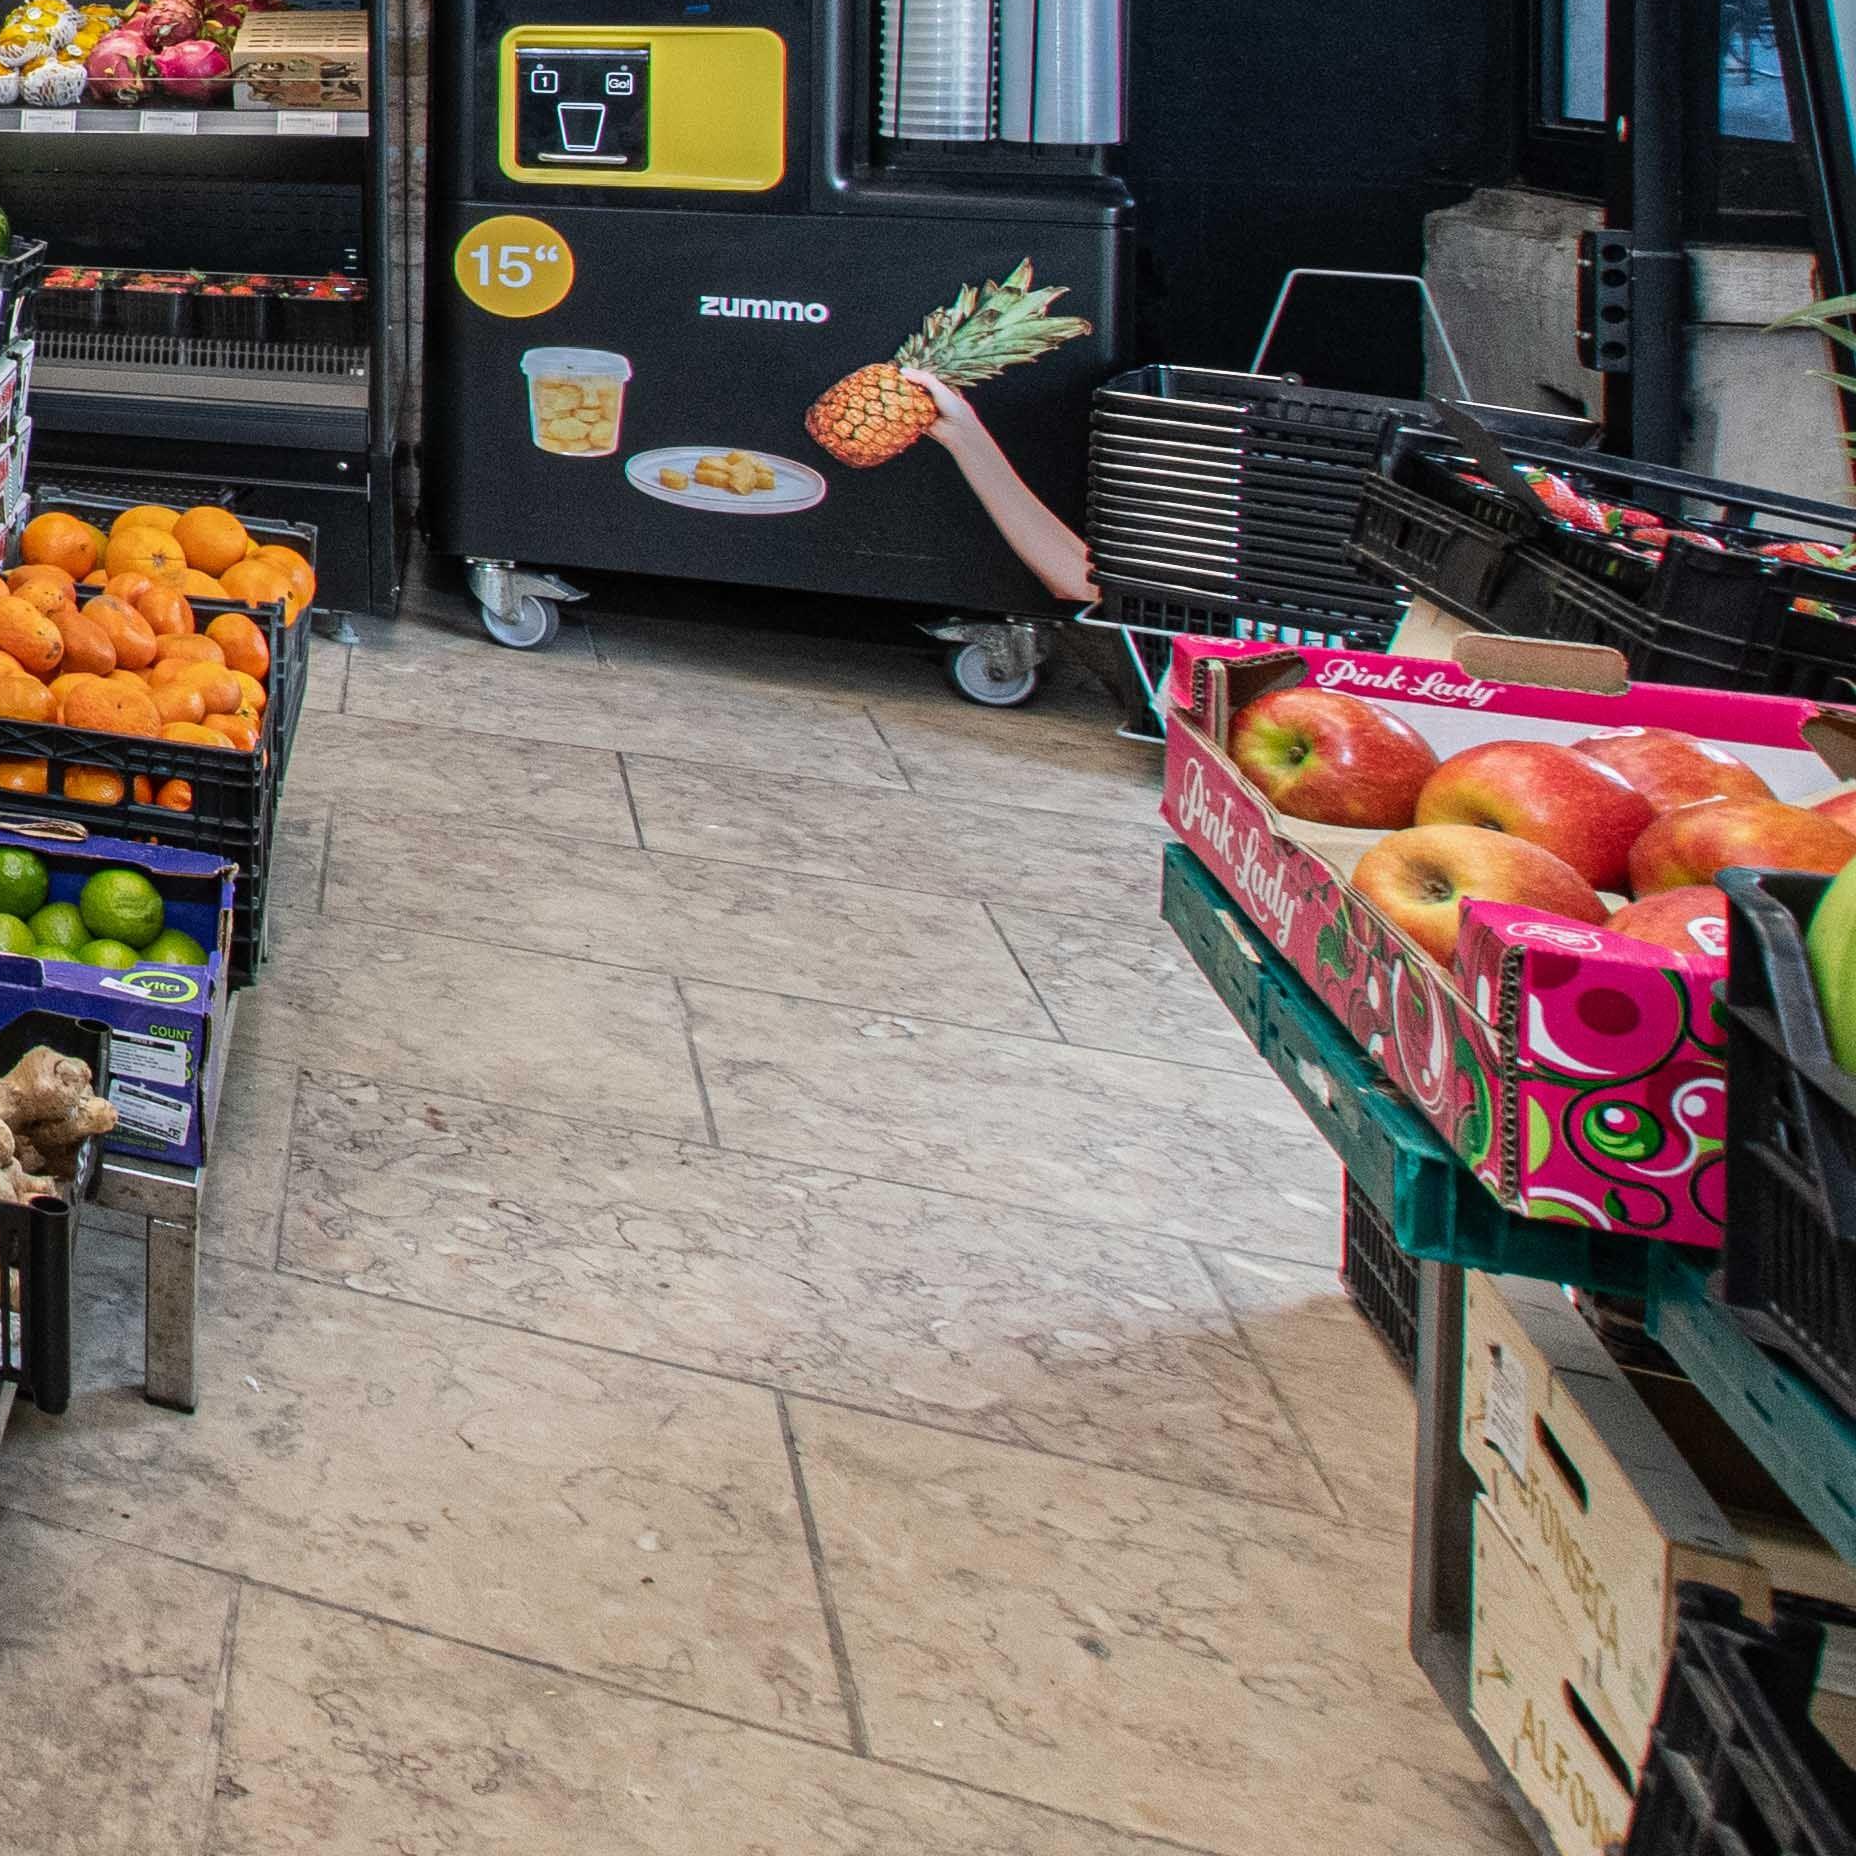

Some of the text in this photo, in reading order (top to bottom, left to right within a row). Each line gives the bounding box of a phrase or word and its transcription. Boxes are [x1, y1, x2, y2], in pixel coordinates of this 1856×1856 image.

[608, 75, 631, 92] Go!
[699, 296, 829, 325] zummo
[1315, 657, 1498, 708] Pink Lady
[1178, 755, 1297, 947] Pink Lady
[140, 980, 180, 993] vita
[149, 1023, 193, 1042] COUNT
